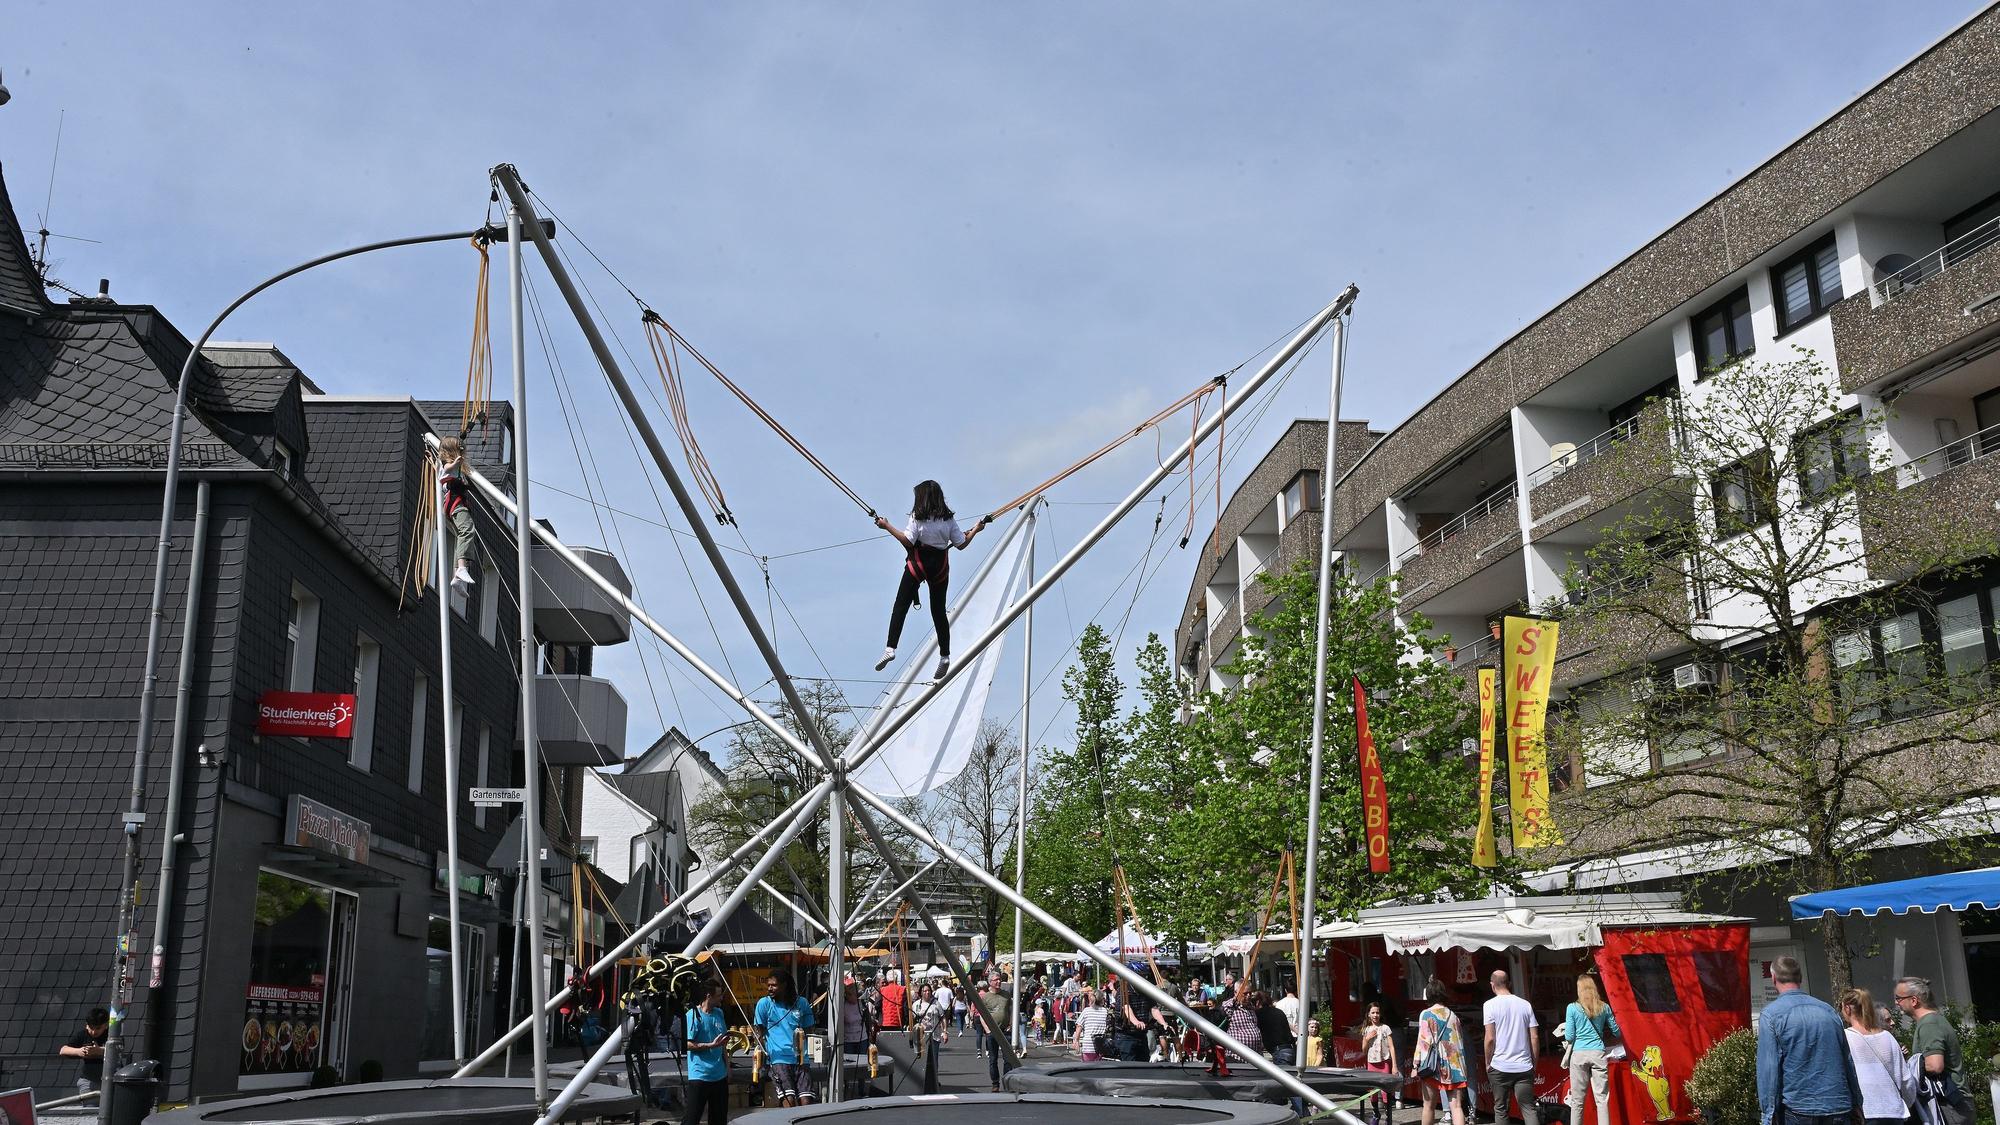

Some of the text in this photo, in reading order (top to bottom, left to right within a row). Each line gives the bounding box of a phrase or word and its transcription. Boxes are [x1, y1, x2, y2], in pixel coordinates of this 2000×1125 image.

[261, 706, 336, 721] Studienkreis
[1512, 627, 1542, 835] SWEETS
[472, 789, 521, 800] Gartenstraße
[299, 802, 330, 841] Pizza
[250, 986, 288, 1000] LIEFERSERVICE
